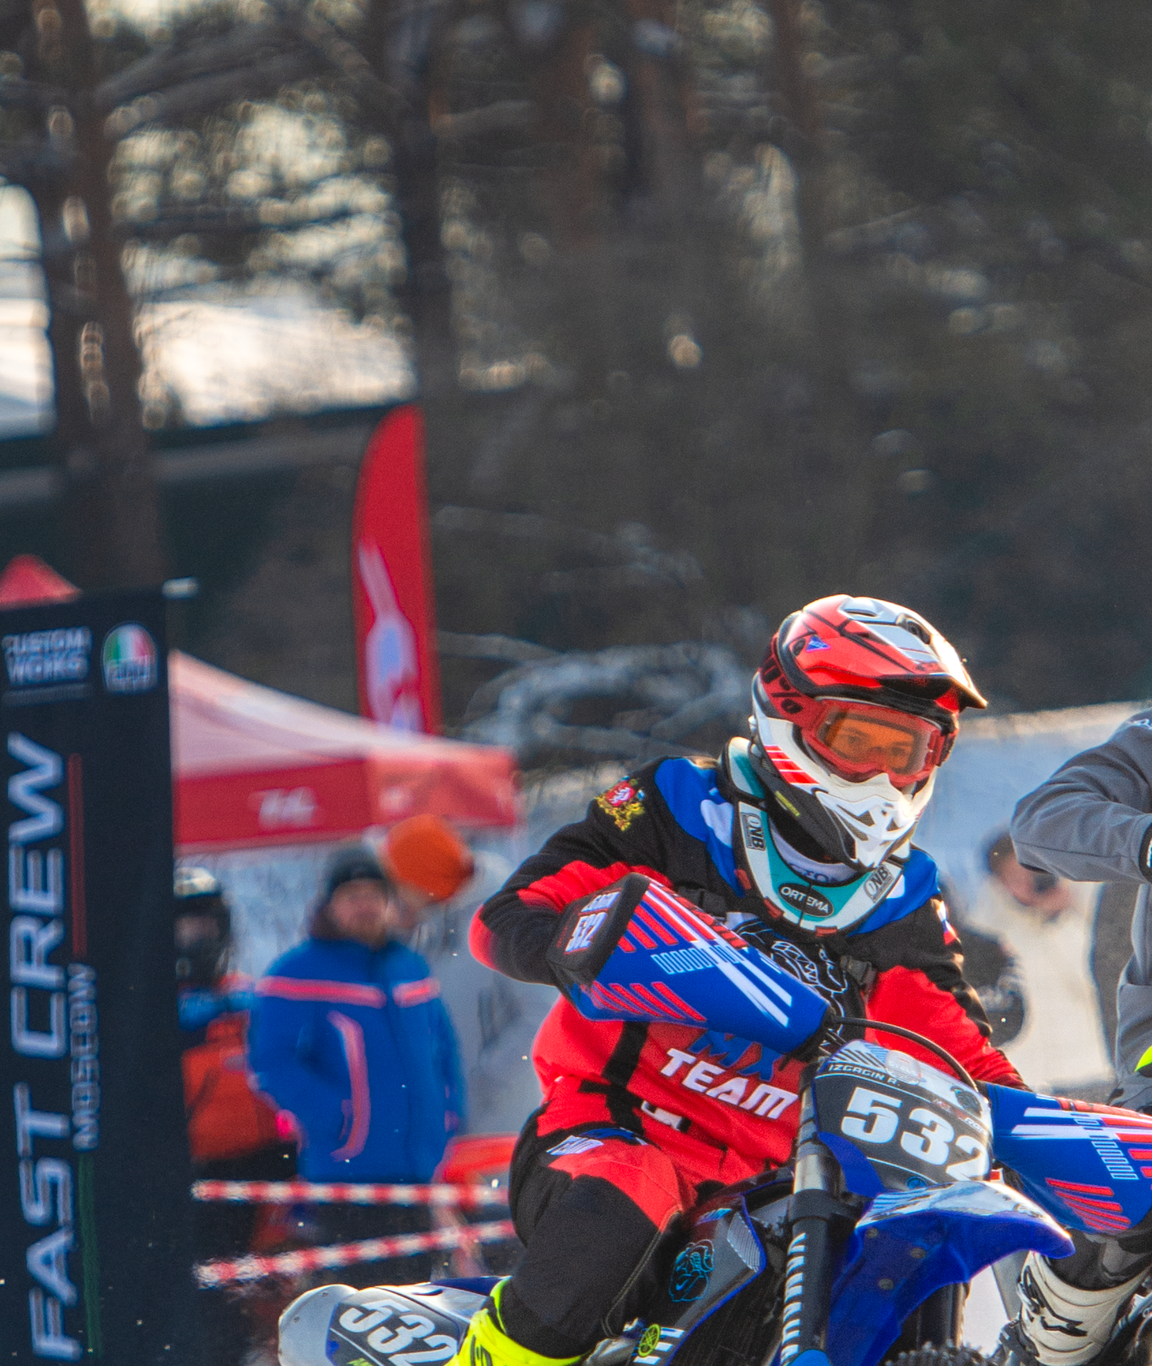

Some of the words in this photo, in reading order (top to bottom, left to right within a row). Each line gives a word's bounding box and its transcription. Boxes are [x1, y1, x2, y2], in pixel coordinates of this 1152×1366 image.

[7, 731, 68, 1060] CREW
[67, 962, 100, 1153] MOSCOW
[660, 1047, 800, 1120] TEAM
[841, 1086, 991, 1183] 532
[13, 1082, 83, 1362] FAST
